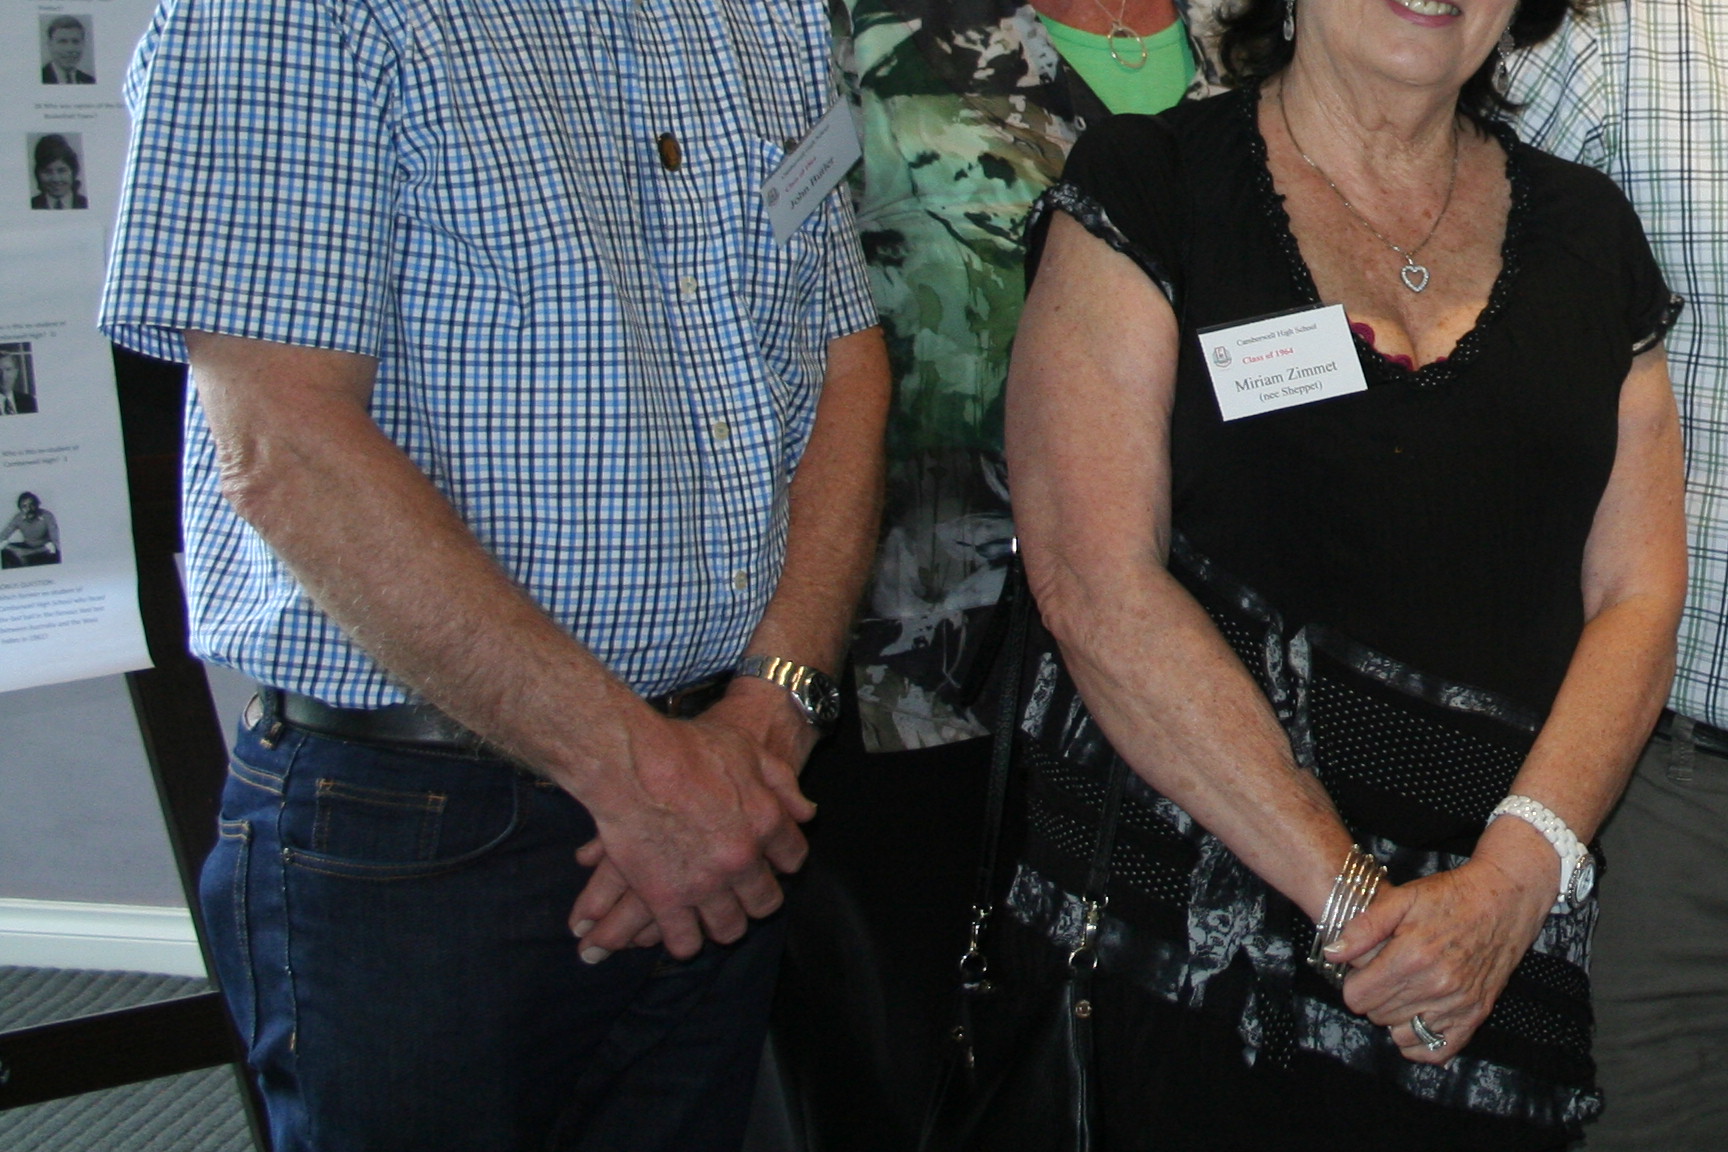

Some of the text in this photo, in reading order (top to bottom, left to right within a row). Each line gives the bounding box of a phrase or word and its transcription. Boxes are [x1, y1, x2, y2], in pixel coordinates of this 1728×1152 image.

[790, 185, 809, 209] John
[1236, 323, 1318, 347] Camberwell High School
[1242, 347, 1294, 365] Class of 1964
[1234, 360, 1338, 393] Miriam Zimmet
[1259, 380, 1324, 403] (nee Sheppet)
